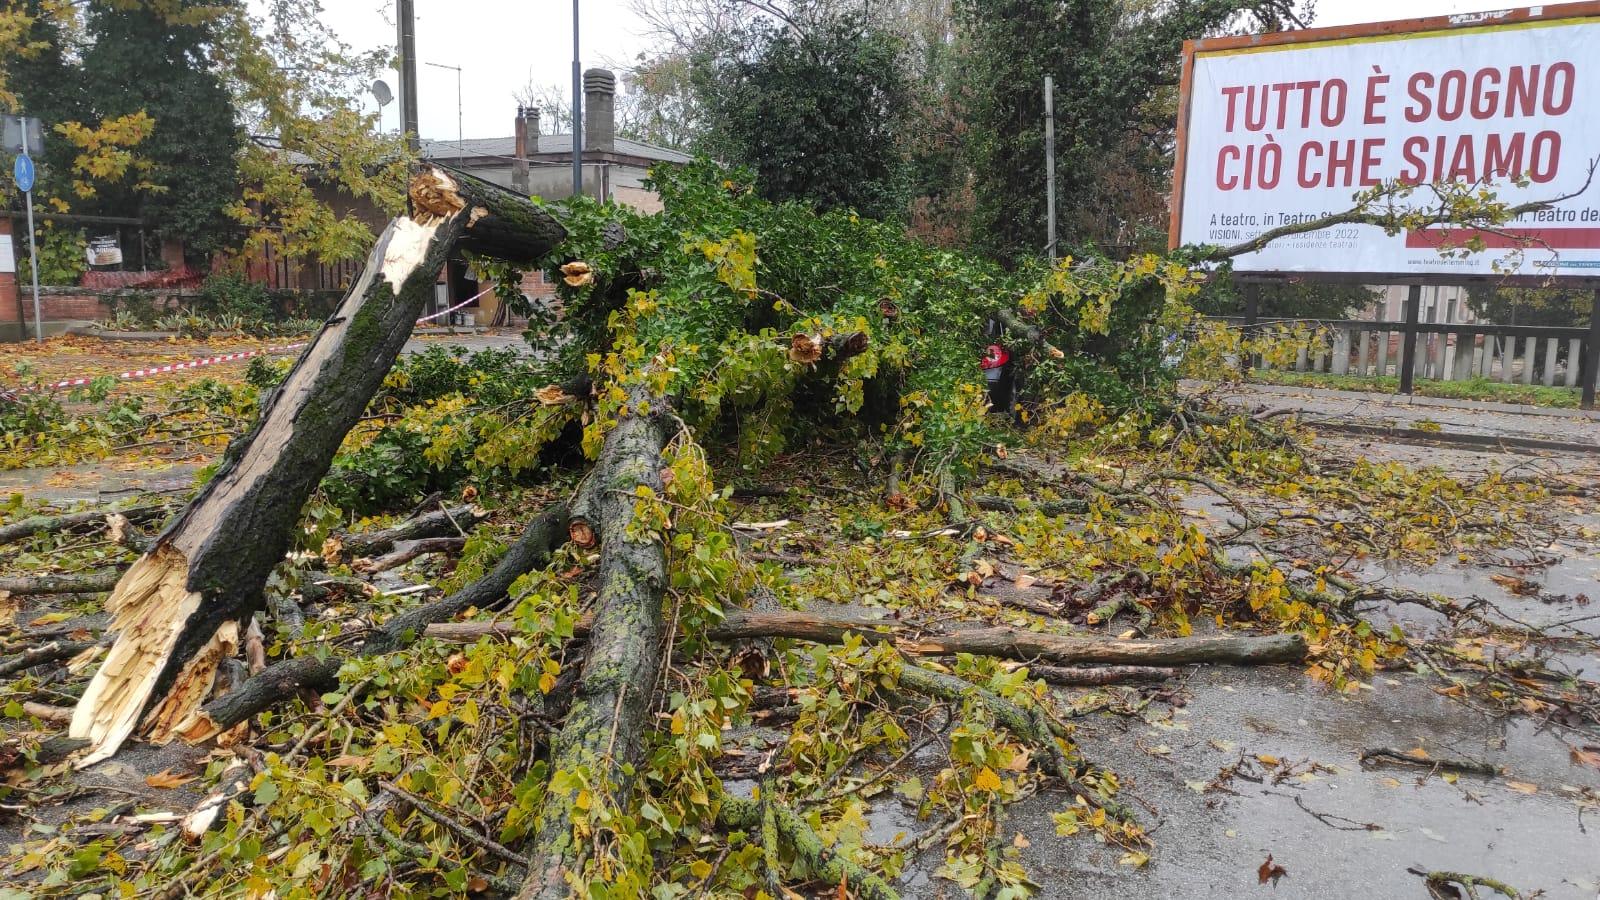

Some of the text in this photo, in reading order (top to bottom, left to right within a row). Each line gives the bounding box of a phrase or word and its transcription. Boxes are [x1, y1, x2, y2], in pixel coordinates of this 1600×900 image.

[1221, 61, 1576, 133] TUTTO È SOGNO
[1216, 130, 1562, 191] CIÒ CHE SIAMO
[1209, 229, 1242, 241] VISIONI,
[1334, 228, 1360, 240] 2022
[1210, 213, 1217, 226] A
[1263, 212, 1274, 226] in
[1278, 211, 1317, 226] Teatro
